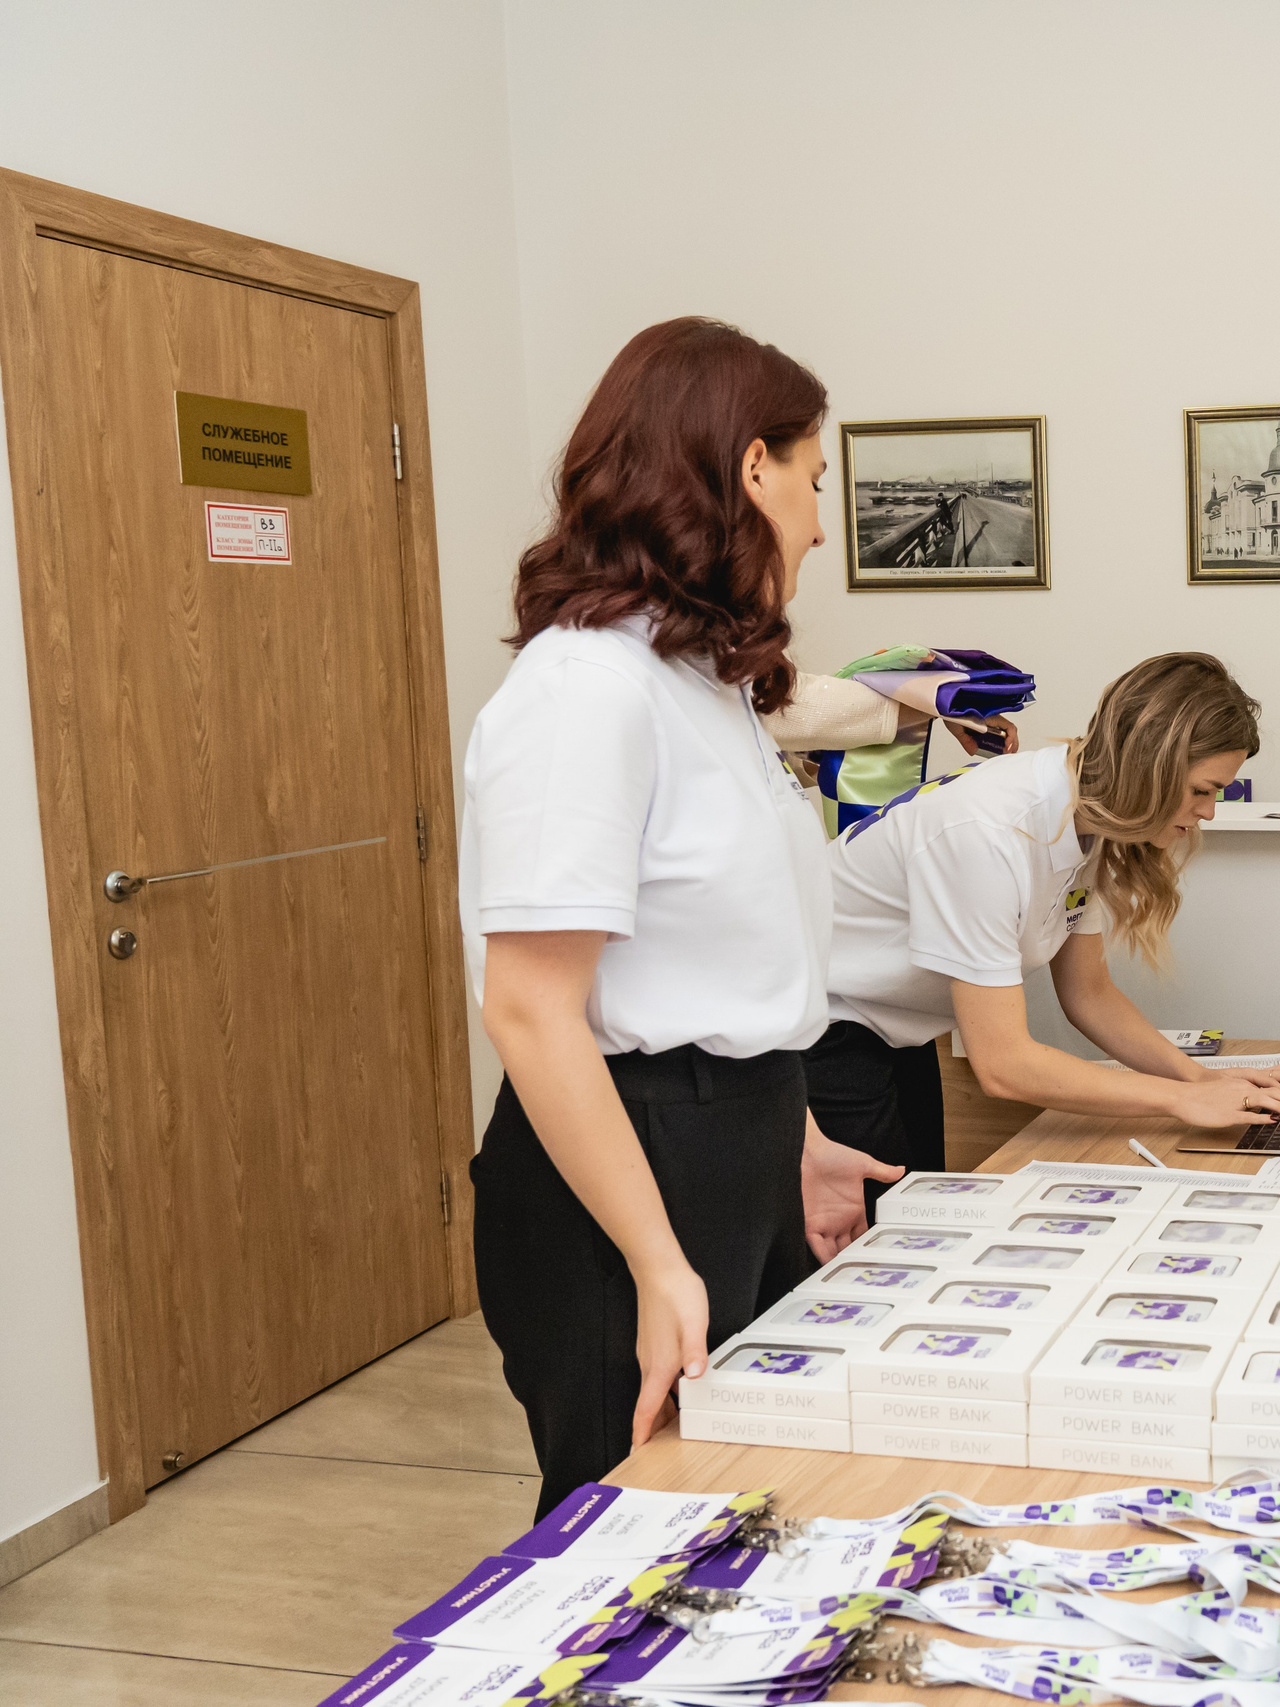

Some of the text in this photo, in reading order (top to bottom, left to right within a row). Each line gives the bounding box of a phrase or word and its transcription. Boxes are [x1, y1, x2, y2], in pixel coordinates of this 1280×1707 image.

[202, 423, 289, 446] СЛУЖЕБНОЕ
[202, 446, 292, 469] ПОМЕЩЕНИЕ
[902, 1206, 988, 1219] POWER BANK
[880, 1372, 990, 1391] POWER BANK
[711, 1389, 816, 1409] POWER BANK
[1064, 1386, 1177, 1406] POWER BANK
[883, 1403, 992, 1423] POWER BANK
[712, 1421, 816, 1441] POWER BANK
[1063, 1416, 1176, 1437] POWER BANK
[884, 1435, 993, 1456] POWER BANK
[1062, 1449, 1174, 1470] POWER BANK
[559, 1494, 602, 1533] УЧАСТНИК
[450, 1567, 512, 1608] УЧАСТНИК
